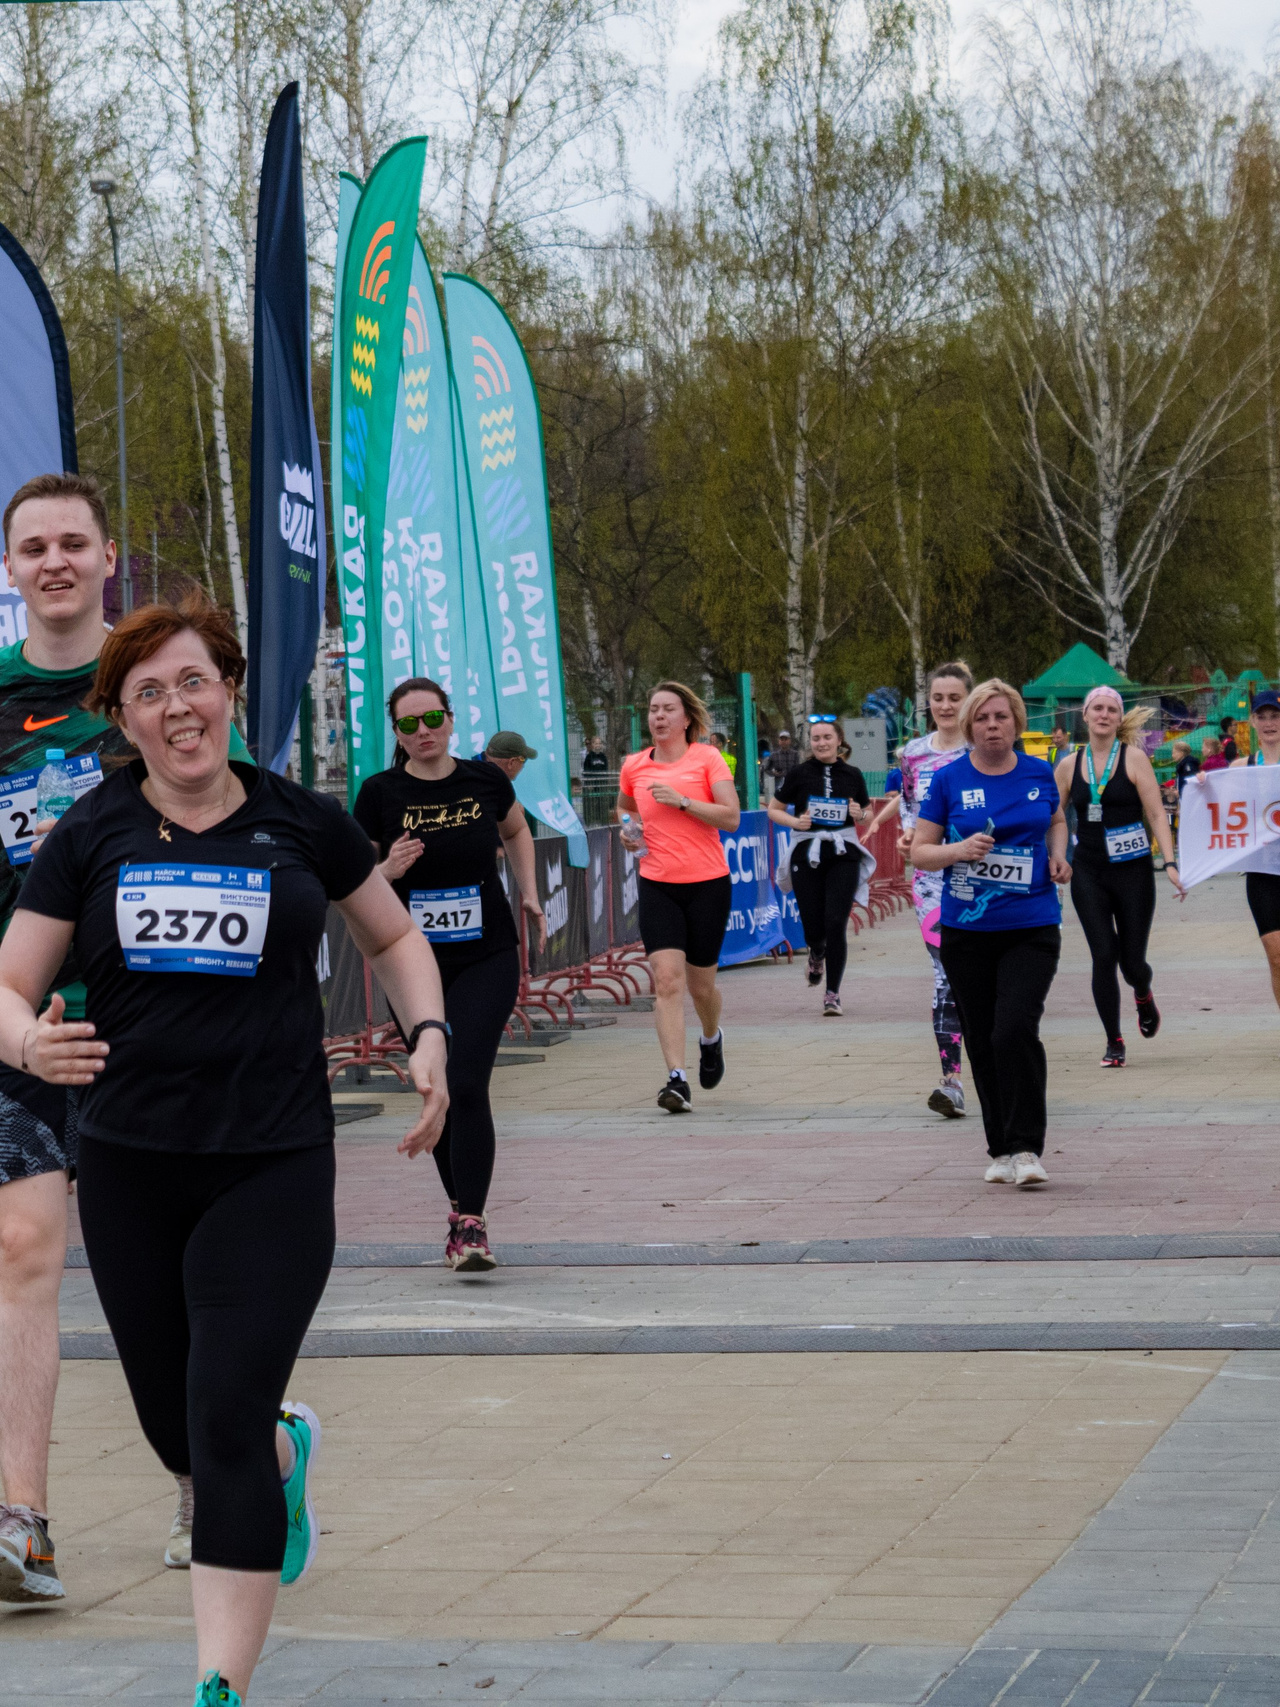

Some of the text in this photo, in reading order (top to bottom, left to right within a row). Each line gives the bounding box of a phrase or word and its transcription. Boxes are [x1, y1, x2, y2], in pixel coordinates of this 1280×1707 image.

[403, 803, 483, 831] Wonderful
[813, 808, 841, 819] 2651
[1206, 801, 1249, 832] 15
[1114, 836, 1146, 853] 2563
[1207, 832, 1250, 851] ЛЕТ
[976, 862, 1023, 881] 2071
[220, 893, 267, 903] ВИКТОРИЯ
[135, 908, 250, 947] 2370
[422, 909, 472, 929] 2417
